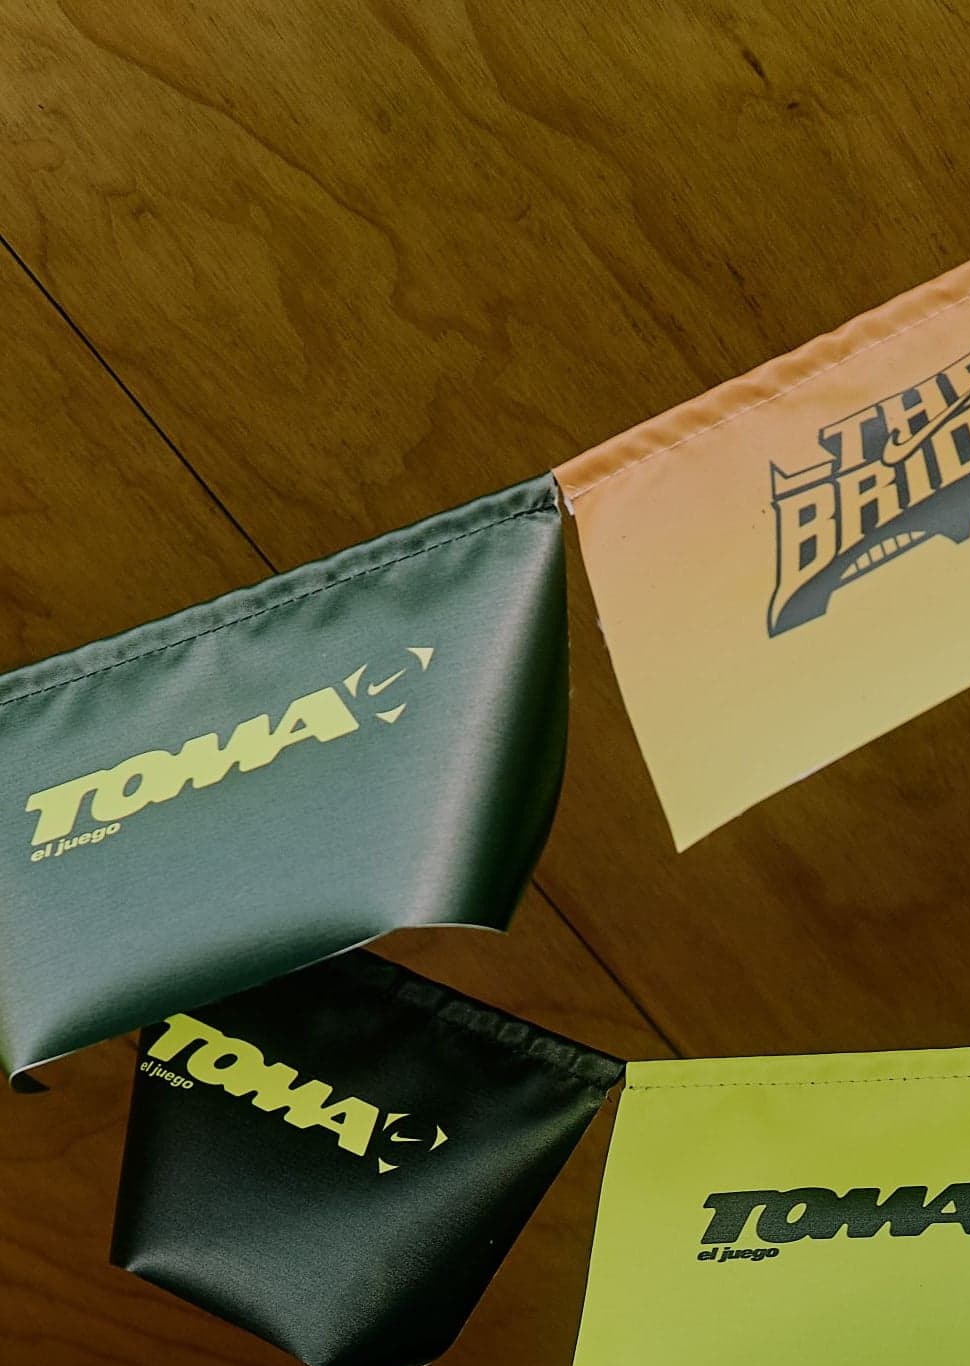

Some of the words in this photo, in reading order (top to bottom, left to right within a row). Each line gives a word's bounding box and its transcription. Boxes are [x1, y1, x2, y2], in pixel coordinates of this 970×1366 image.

[25, 687, 359, 846] TOMA
[30, 842, 51, 862] el
[54, 823, 121, 857] juego
[140, 1060, 154, 1072] el
[149, 1063, 194, 1089] juego
[146, 1012, 379, 1157] TOMA
[697, 1248, 716, 1261] el
[717, 1246, 780, 1263] juego
